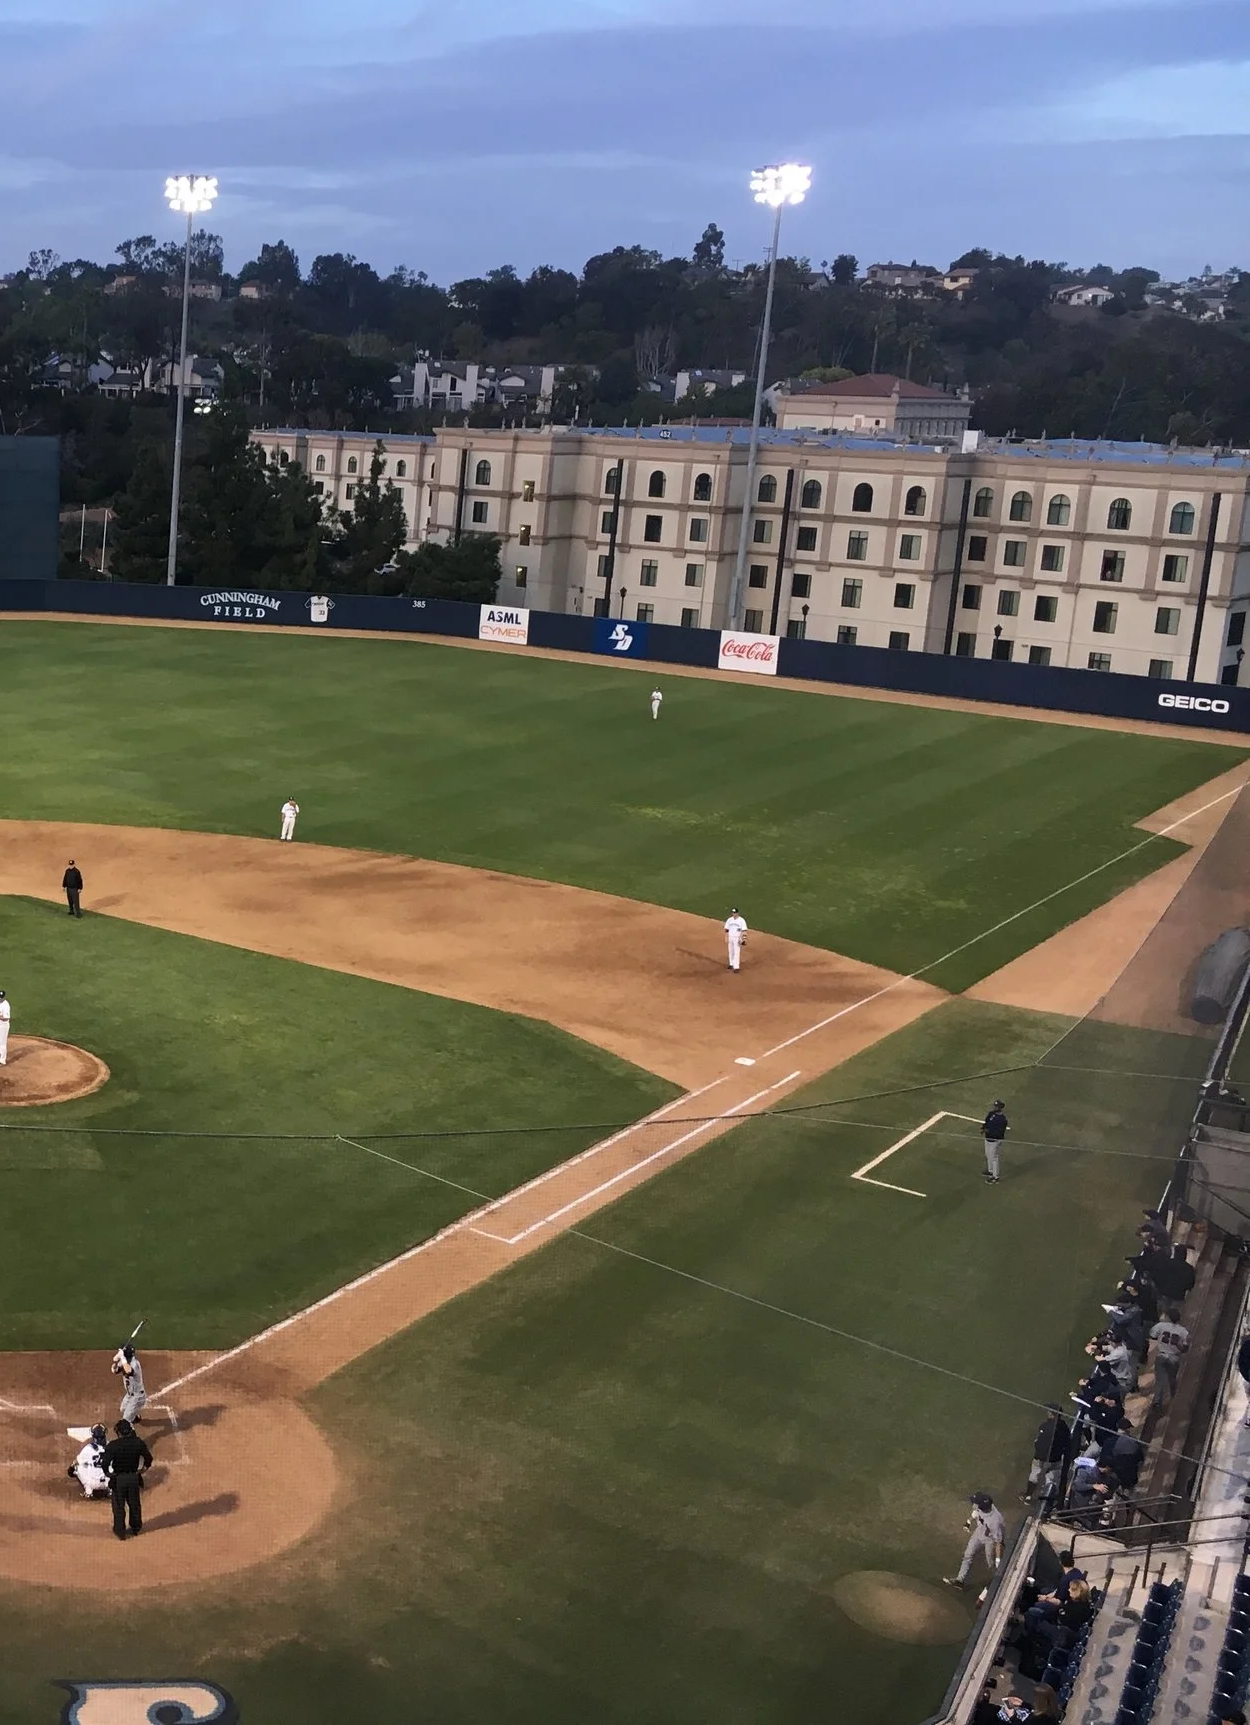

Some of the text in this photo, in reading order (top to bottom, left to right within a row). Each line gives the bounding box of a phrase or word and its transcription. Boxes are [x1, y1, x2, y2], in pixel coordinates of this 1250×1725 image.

[200, 591, 281, 611] CUNNINGHAM
[412, 600, 426, 608] 385
[213, 605, 266, 618] FIELD
[487, 610, 522, 625] ASML
[480, 625, 527, 639] CYMER
[1157, 693, 1230, 714] GEICO
